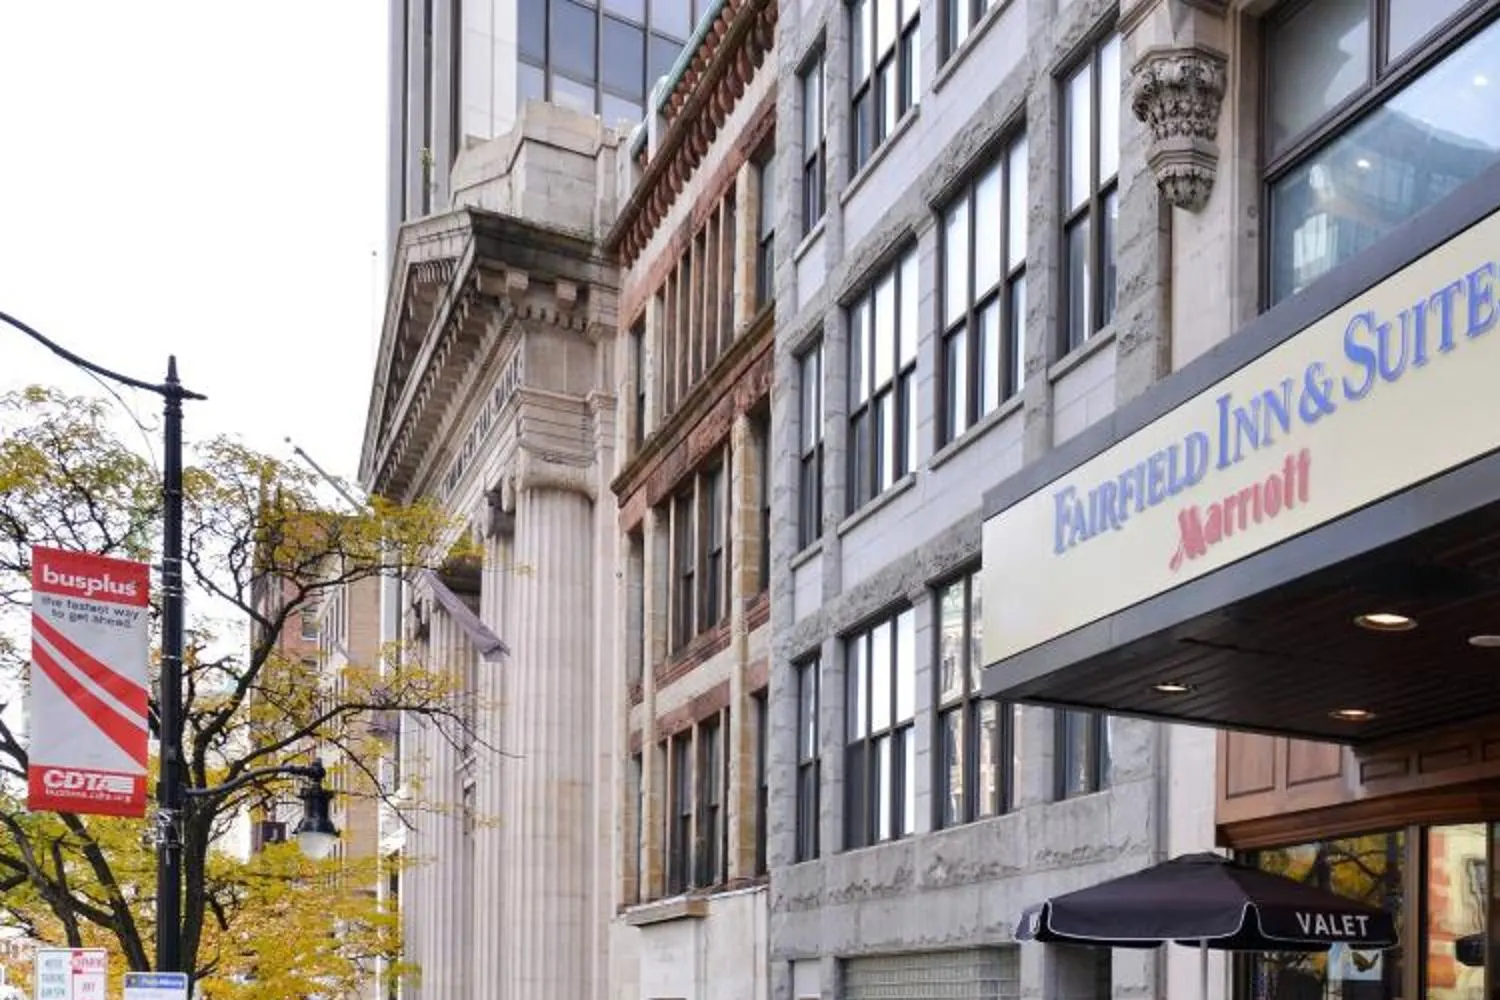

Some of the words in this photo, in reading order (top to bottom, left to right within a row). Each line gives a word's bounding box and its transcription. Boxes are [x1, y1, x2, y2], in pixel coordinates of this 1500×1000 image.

[1053, 431, 1209, 555] FAIRFIELD
[1216, 378, 1295, 471] INN
[1299, 360, 1337, 424] &
[1169, 447, 1312, 573] Marriott
[42, 564, 137, 596] busplus
[1295, 911, 1369, 937] VALET
